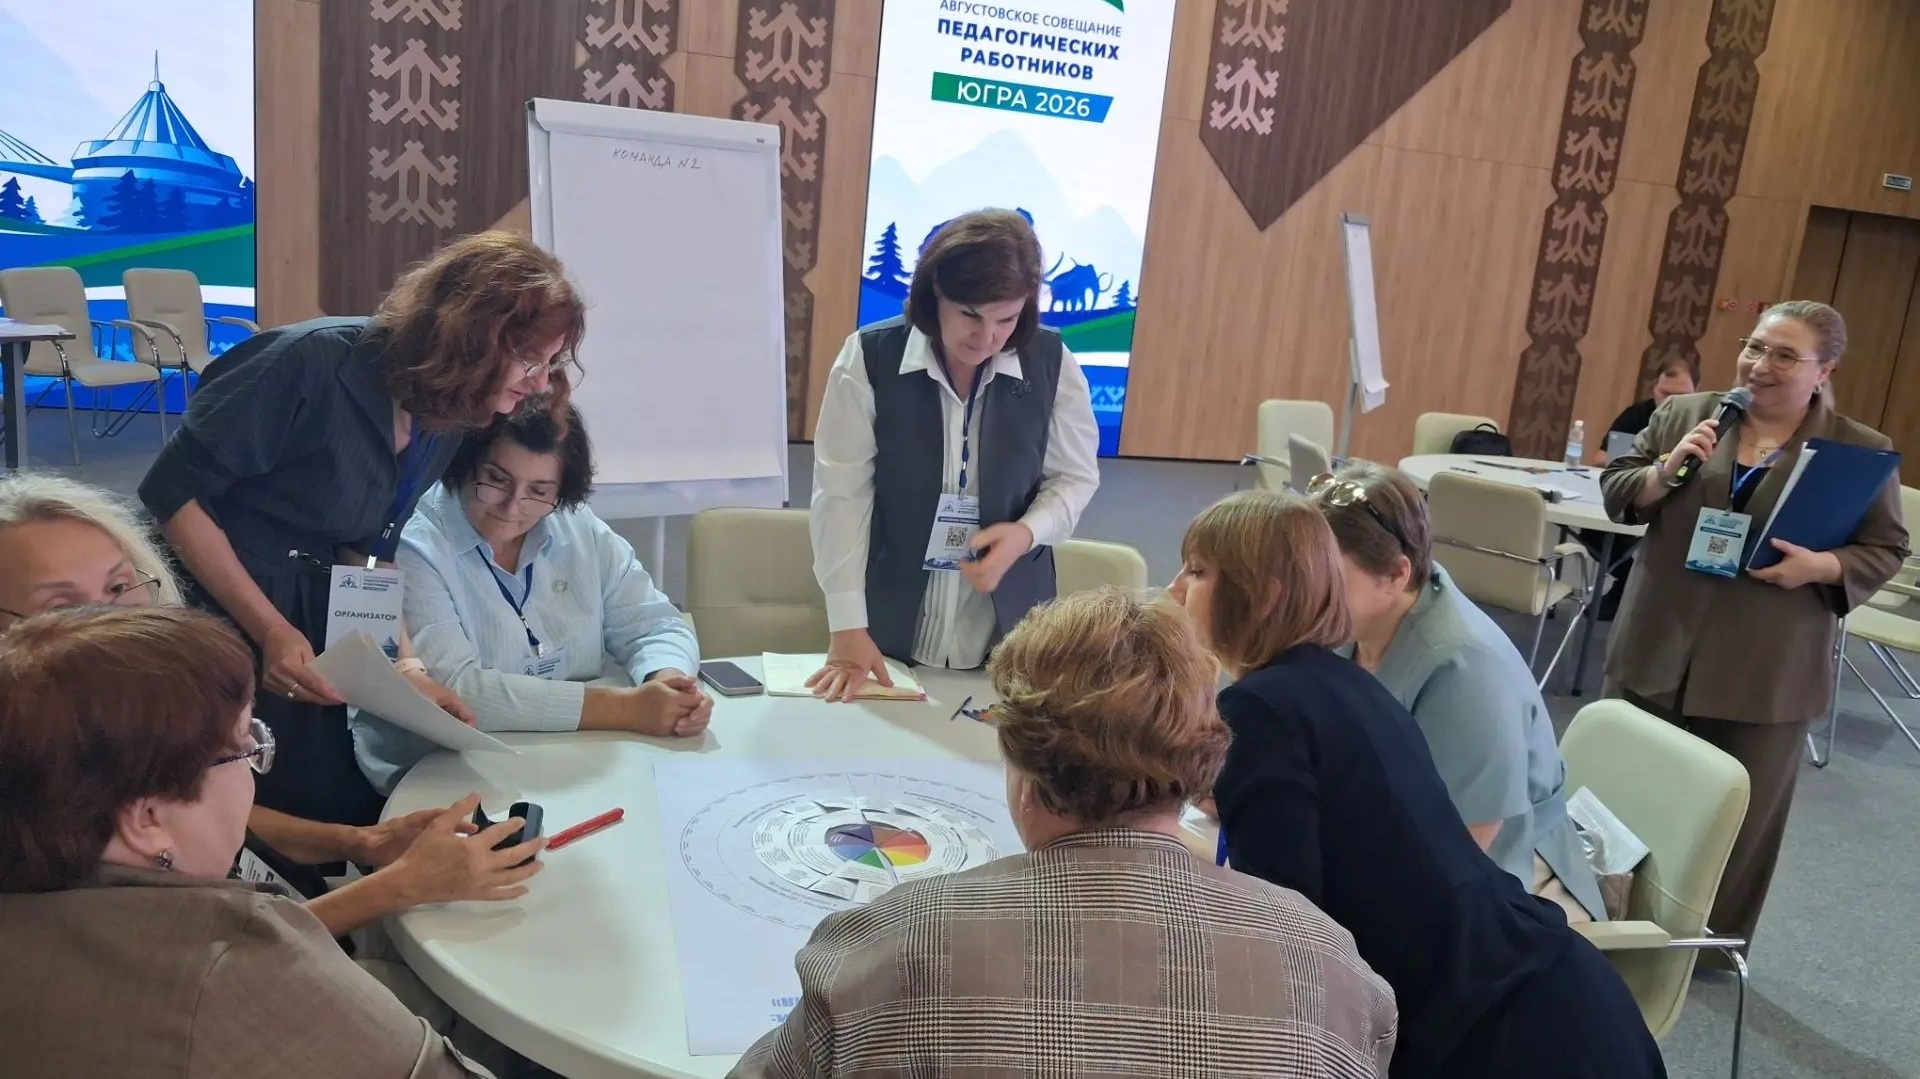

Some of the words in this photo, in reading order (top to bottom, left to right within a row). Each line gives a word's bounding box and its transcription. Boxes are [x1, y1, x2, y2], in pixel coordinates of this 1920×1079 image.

[939, 0, 1039, 25] АВГУСТОВСКОЕ
[1042, 14, 1122, 38] СОВЕЩАНИЕ
[937, 18, 1120, 60] ПЕДАГОГИЧЕСКИХ
[960, 47, 1094, 81] РАБОТНИКОВ
[957, 80, 1028, 109] ЮГРА
[1034, 91, 1091, 118] 2026
[613, 147, 671, 170] КОМАНДА
[334, 610, 397, 621] ОРГАНИЗАТОР
